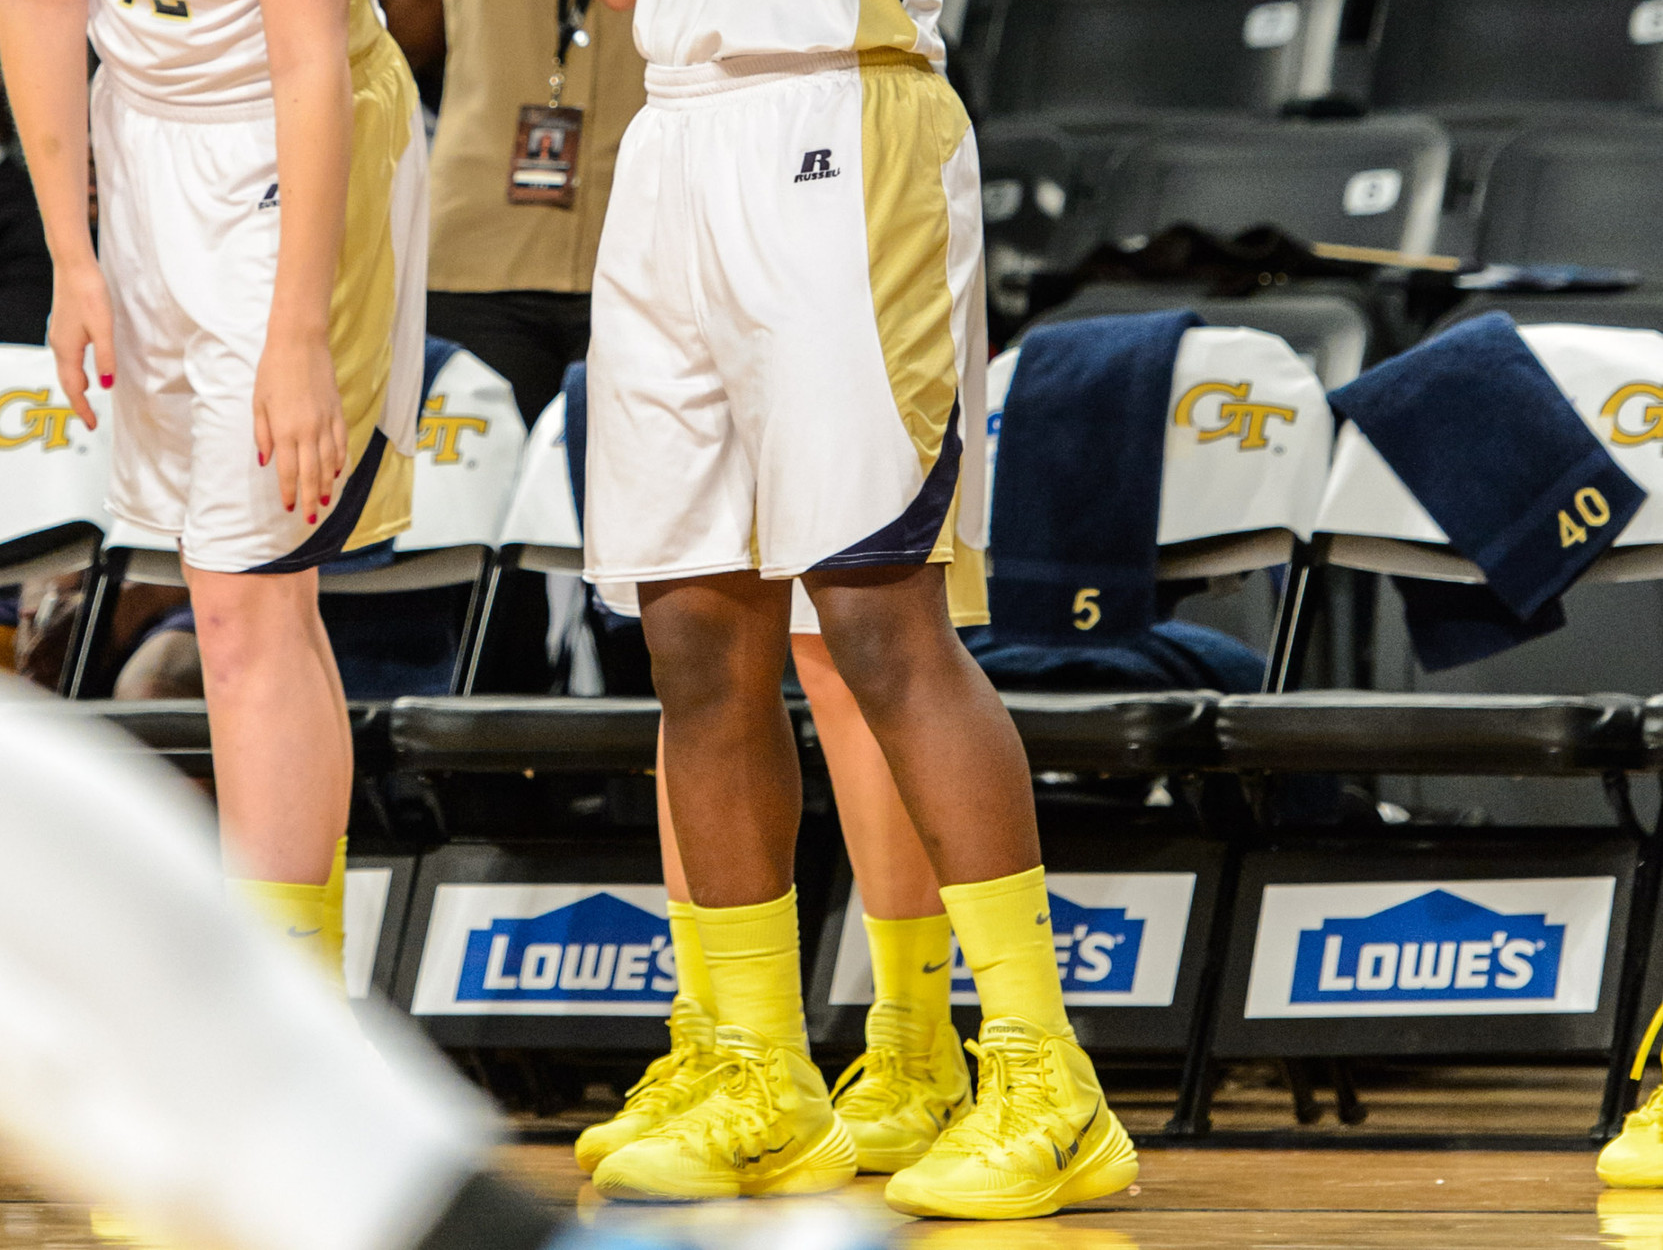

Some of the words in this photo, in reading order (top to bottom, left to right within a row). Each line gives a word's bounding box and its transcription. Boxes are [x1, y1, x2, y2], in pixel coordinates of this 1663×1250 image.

[800, 148, 832, 173] R
[1173, 380, 1297, 452] GT
[1558, 486, 1611, 549] 40
[1072, 588, 1101, 631] 5
[482, 934, 679, 992] LOWE'S
[1318, 931, 1538, 991] LOWE'S
